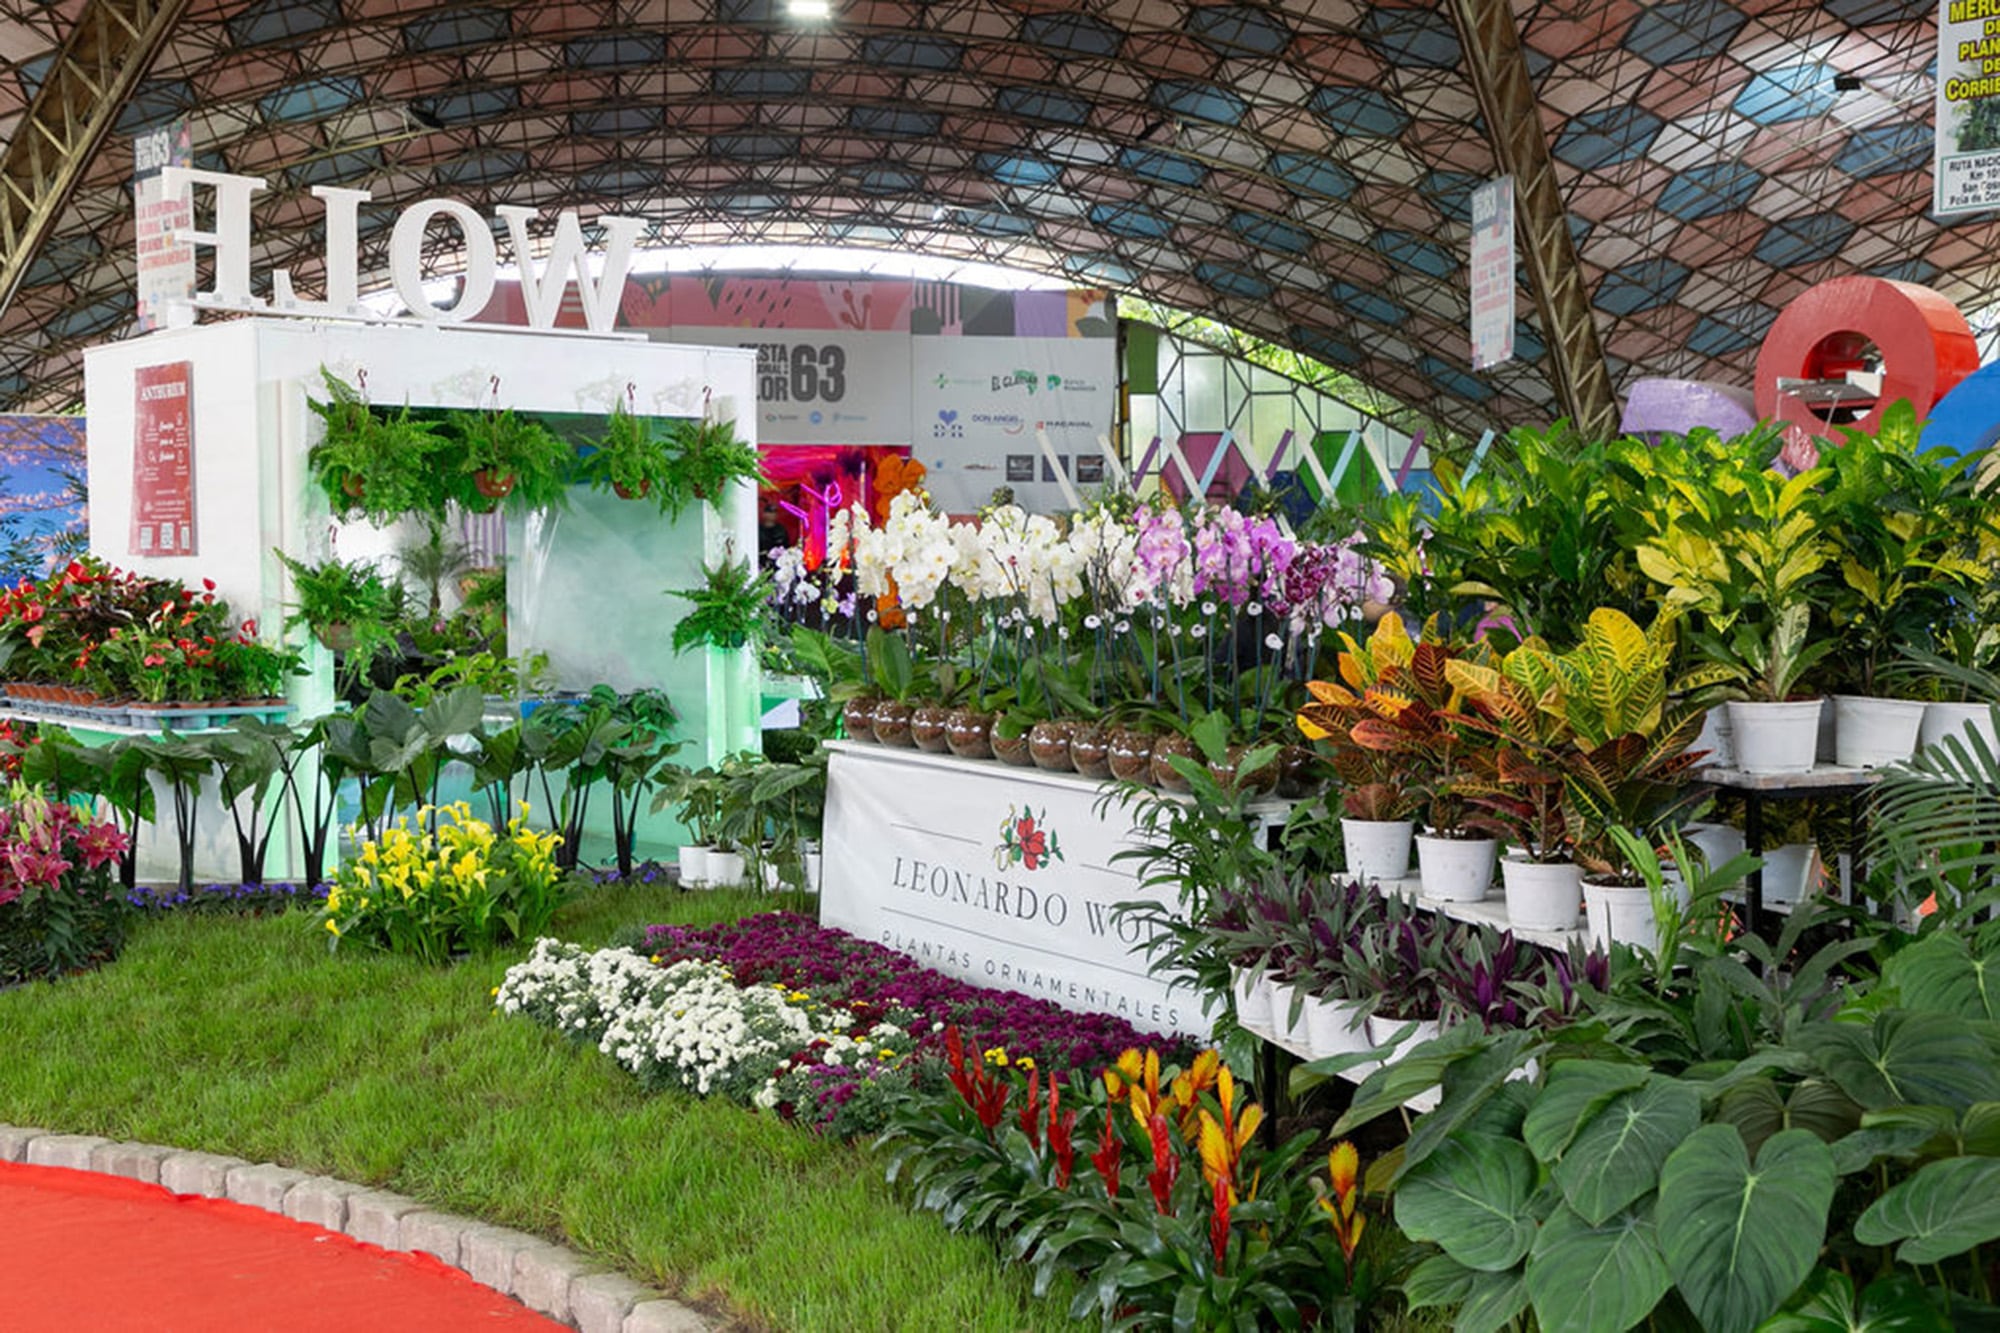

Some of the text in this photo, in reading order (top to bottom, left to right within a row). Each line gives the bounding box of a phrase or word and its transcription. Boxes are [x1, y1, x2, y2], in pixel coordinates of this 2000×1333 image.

[1949, 159, 1971, 171] RUTA
[757, 375, 788, 401] OR
[790, 343, 846, 402] 63
[893, 856, 1067, 927] LEONARDO
[881, 929, 1179, 1027] PLANTAS ORNAMENTALES
